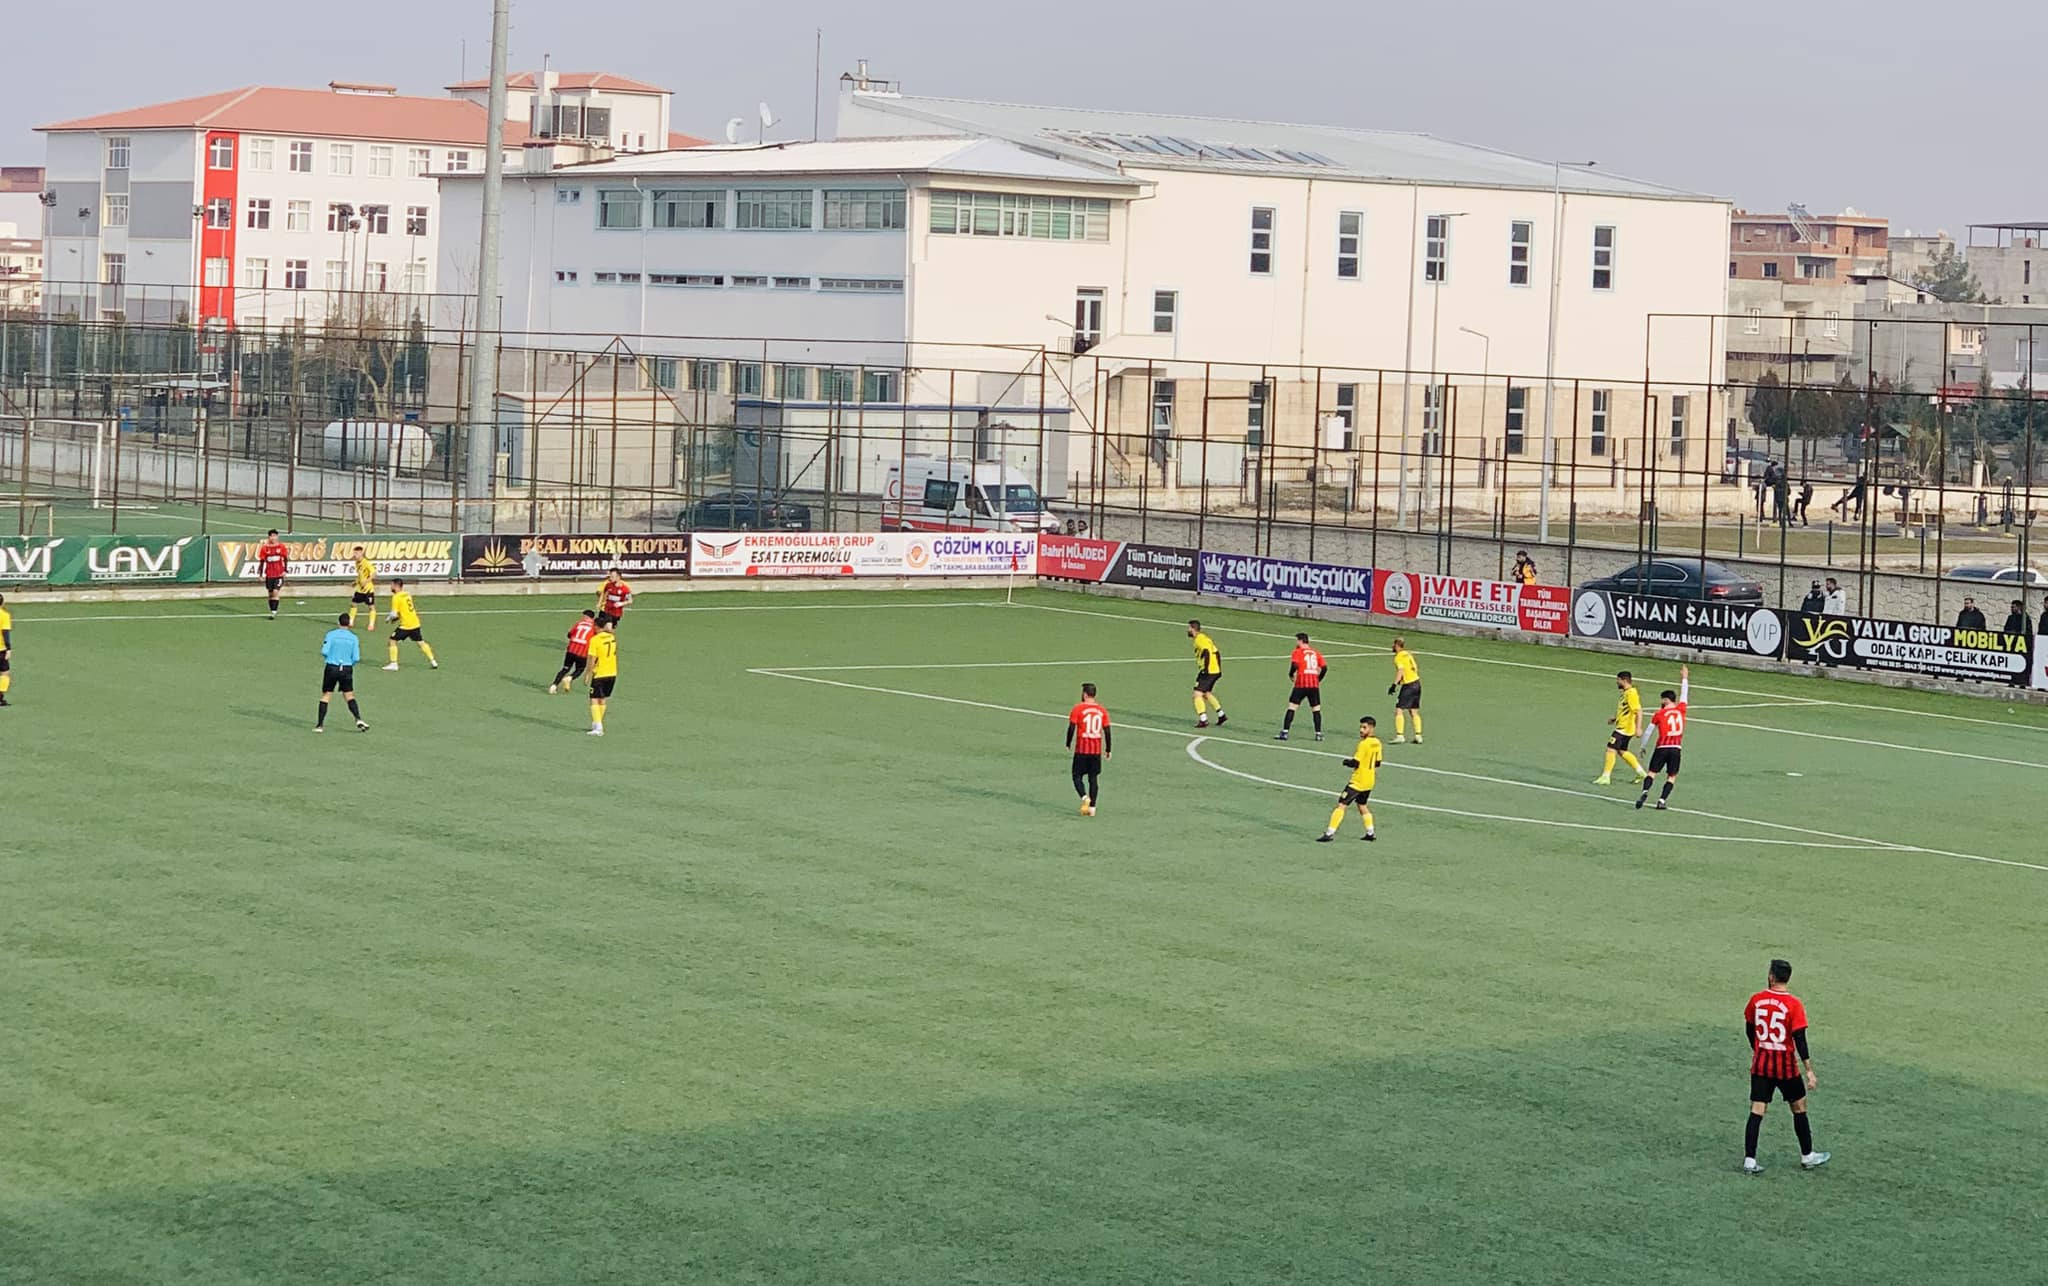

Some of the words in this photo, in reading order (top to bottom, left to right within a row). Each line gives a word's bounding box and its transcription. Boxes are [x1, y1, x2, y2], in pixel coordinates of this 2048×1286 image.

[520, 538, 567, 554] REAL
[569, 538, 628, 554] KONAK
[631, 538, 687, 554] HOTEL
[843, 536, 874, 546] GRUP
[933, 536, 981, 557] ÇÖZÜM
[751, 551, 780, 563] ESAT
[1041, 544, 1065, 558] Bahri
[1066, 542, 1107, 561] MÜJDECİ
[1127, 549, 1146, 562] Tüm
[1147, 551, 1193, 567] Takımlara
[304, 563, 337, 575] TUNÇ
[394, 563, 413, 573] 481
[416, 563, 430, 573] 37
[432, 562, 446, 573] 21
[546, 559, 599, 571] TAKIMLARA
[658, 558, 686, 570] DİLER
[1126, 564, 1168, 579] Başarılar
[1490, 583, 1517, 603] ET
[1423, 596, 1466, 609] ENTEGRE
[1422, 606, 1447, 617] CANLI
[1447, 610, 1480, 620] HAYVAN
[1481, 613, 1516, 624] BORSASI
[1616, 596, 1678, 624] SİNAN
[1685, 605, 1748, 631] SALİM
[1621, 625, 1637, 637] TÜM
[1638, 629, 1681, 643] TAKIMLARA
[1725, 636, 1748, 650] DİLER
[1752, 622, 1779, 641] VIP
[1852, 619, 1906, 642] YAYLA
[1908, 625, 1951, 645] GRUP
[1303, 653, 1318, 669] 16
[1871, 643, 1893, 656] ODA
[1908, 648, 1936, 661] KAPI
[1980, 653, 2009, 669] KAPI
[1083, 714, 1101, 736] 10
[1755, 1008, 1787, 1043] 55
